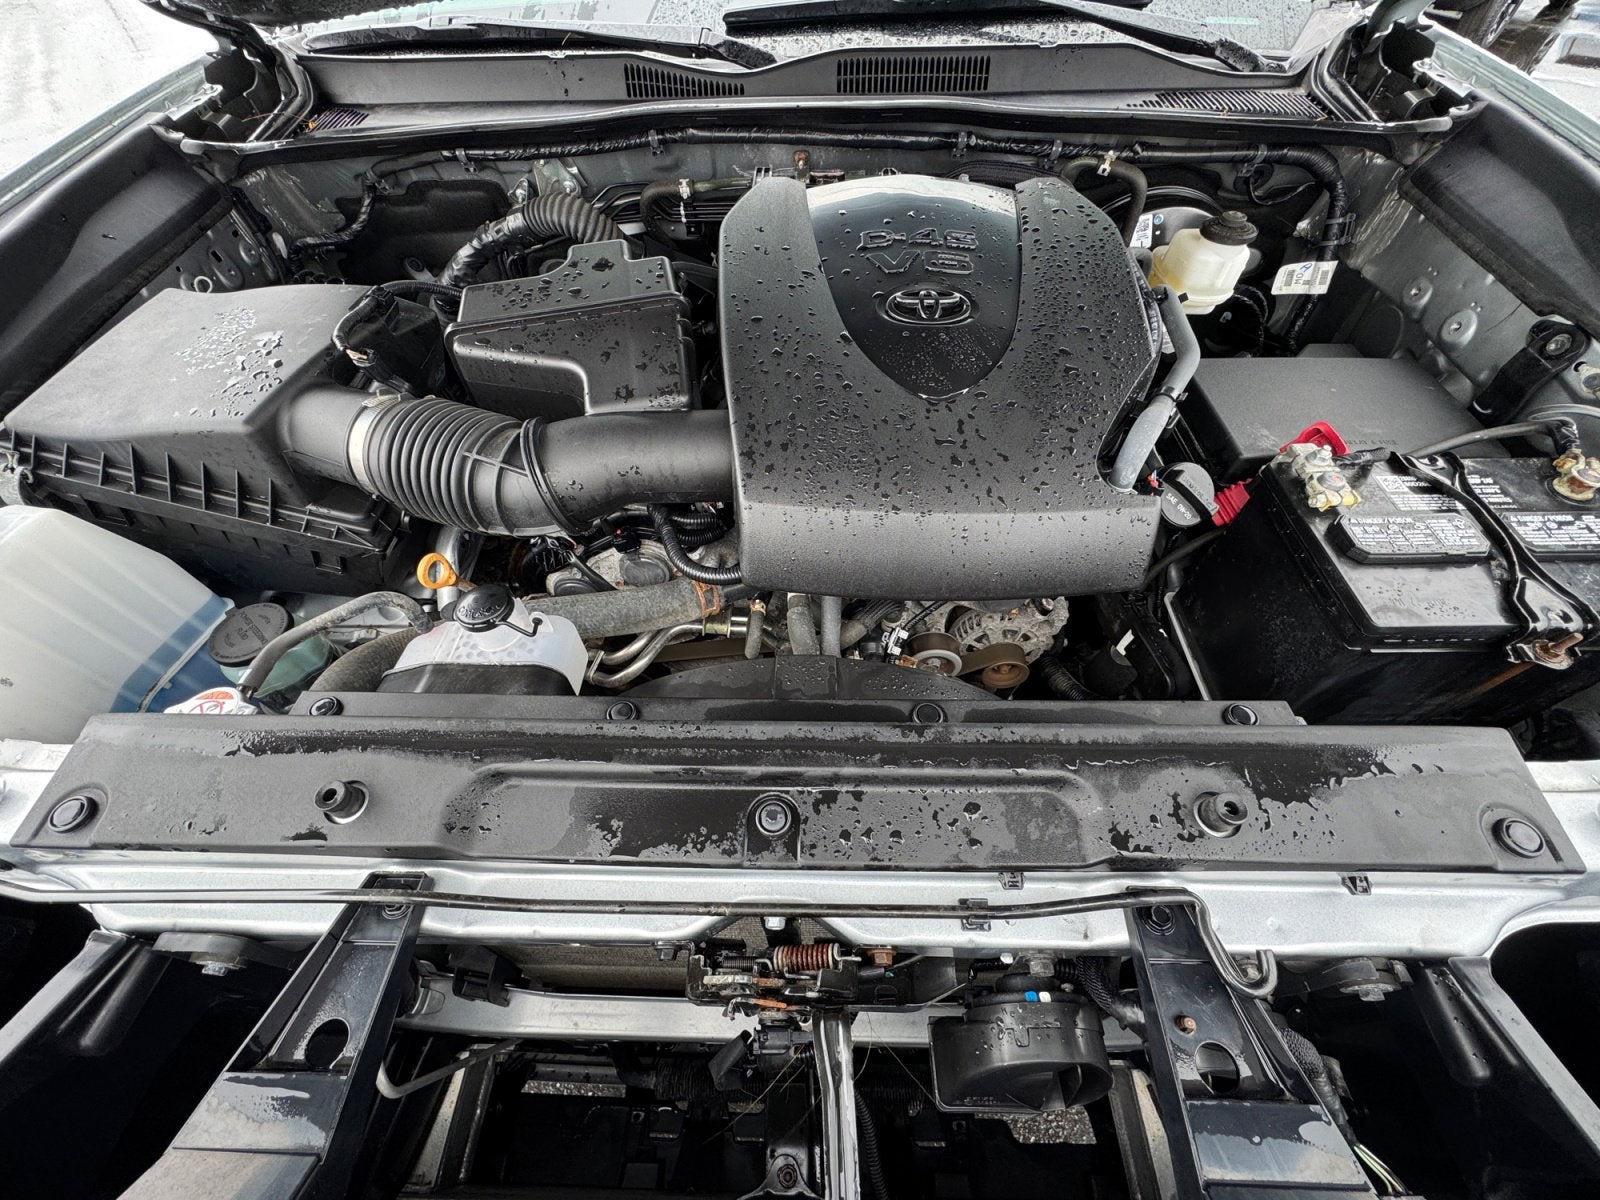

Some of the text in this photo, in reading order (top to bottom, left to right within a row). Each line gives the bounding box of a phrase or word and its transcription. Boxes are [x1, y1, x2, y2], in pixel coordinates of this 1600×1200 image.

[856, 227, 979, 251] D-4S
[864, 249, 975, 275] V6
[1165, 492, 1178, 505] SAE
